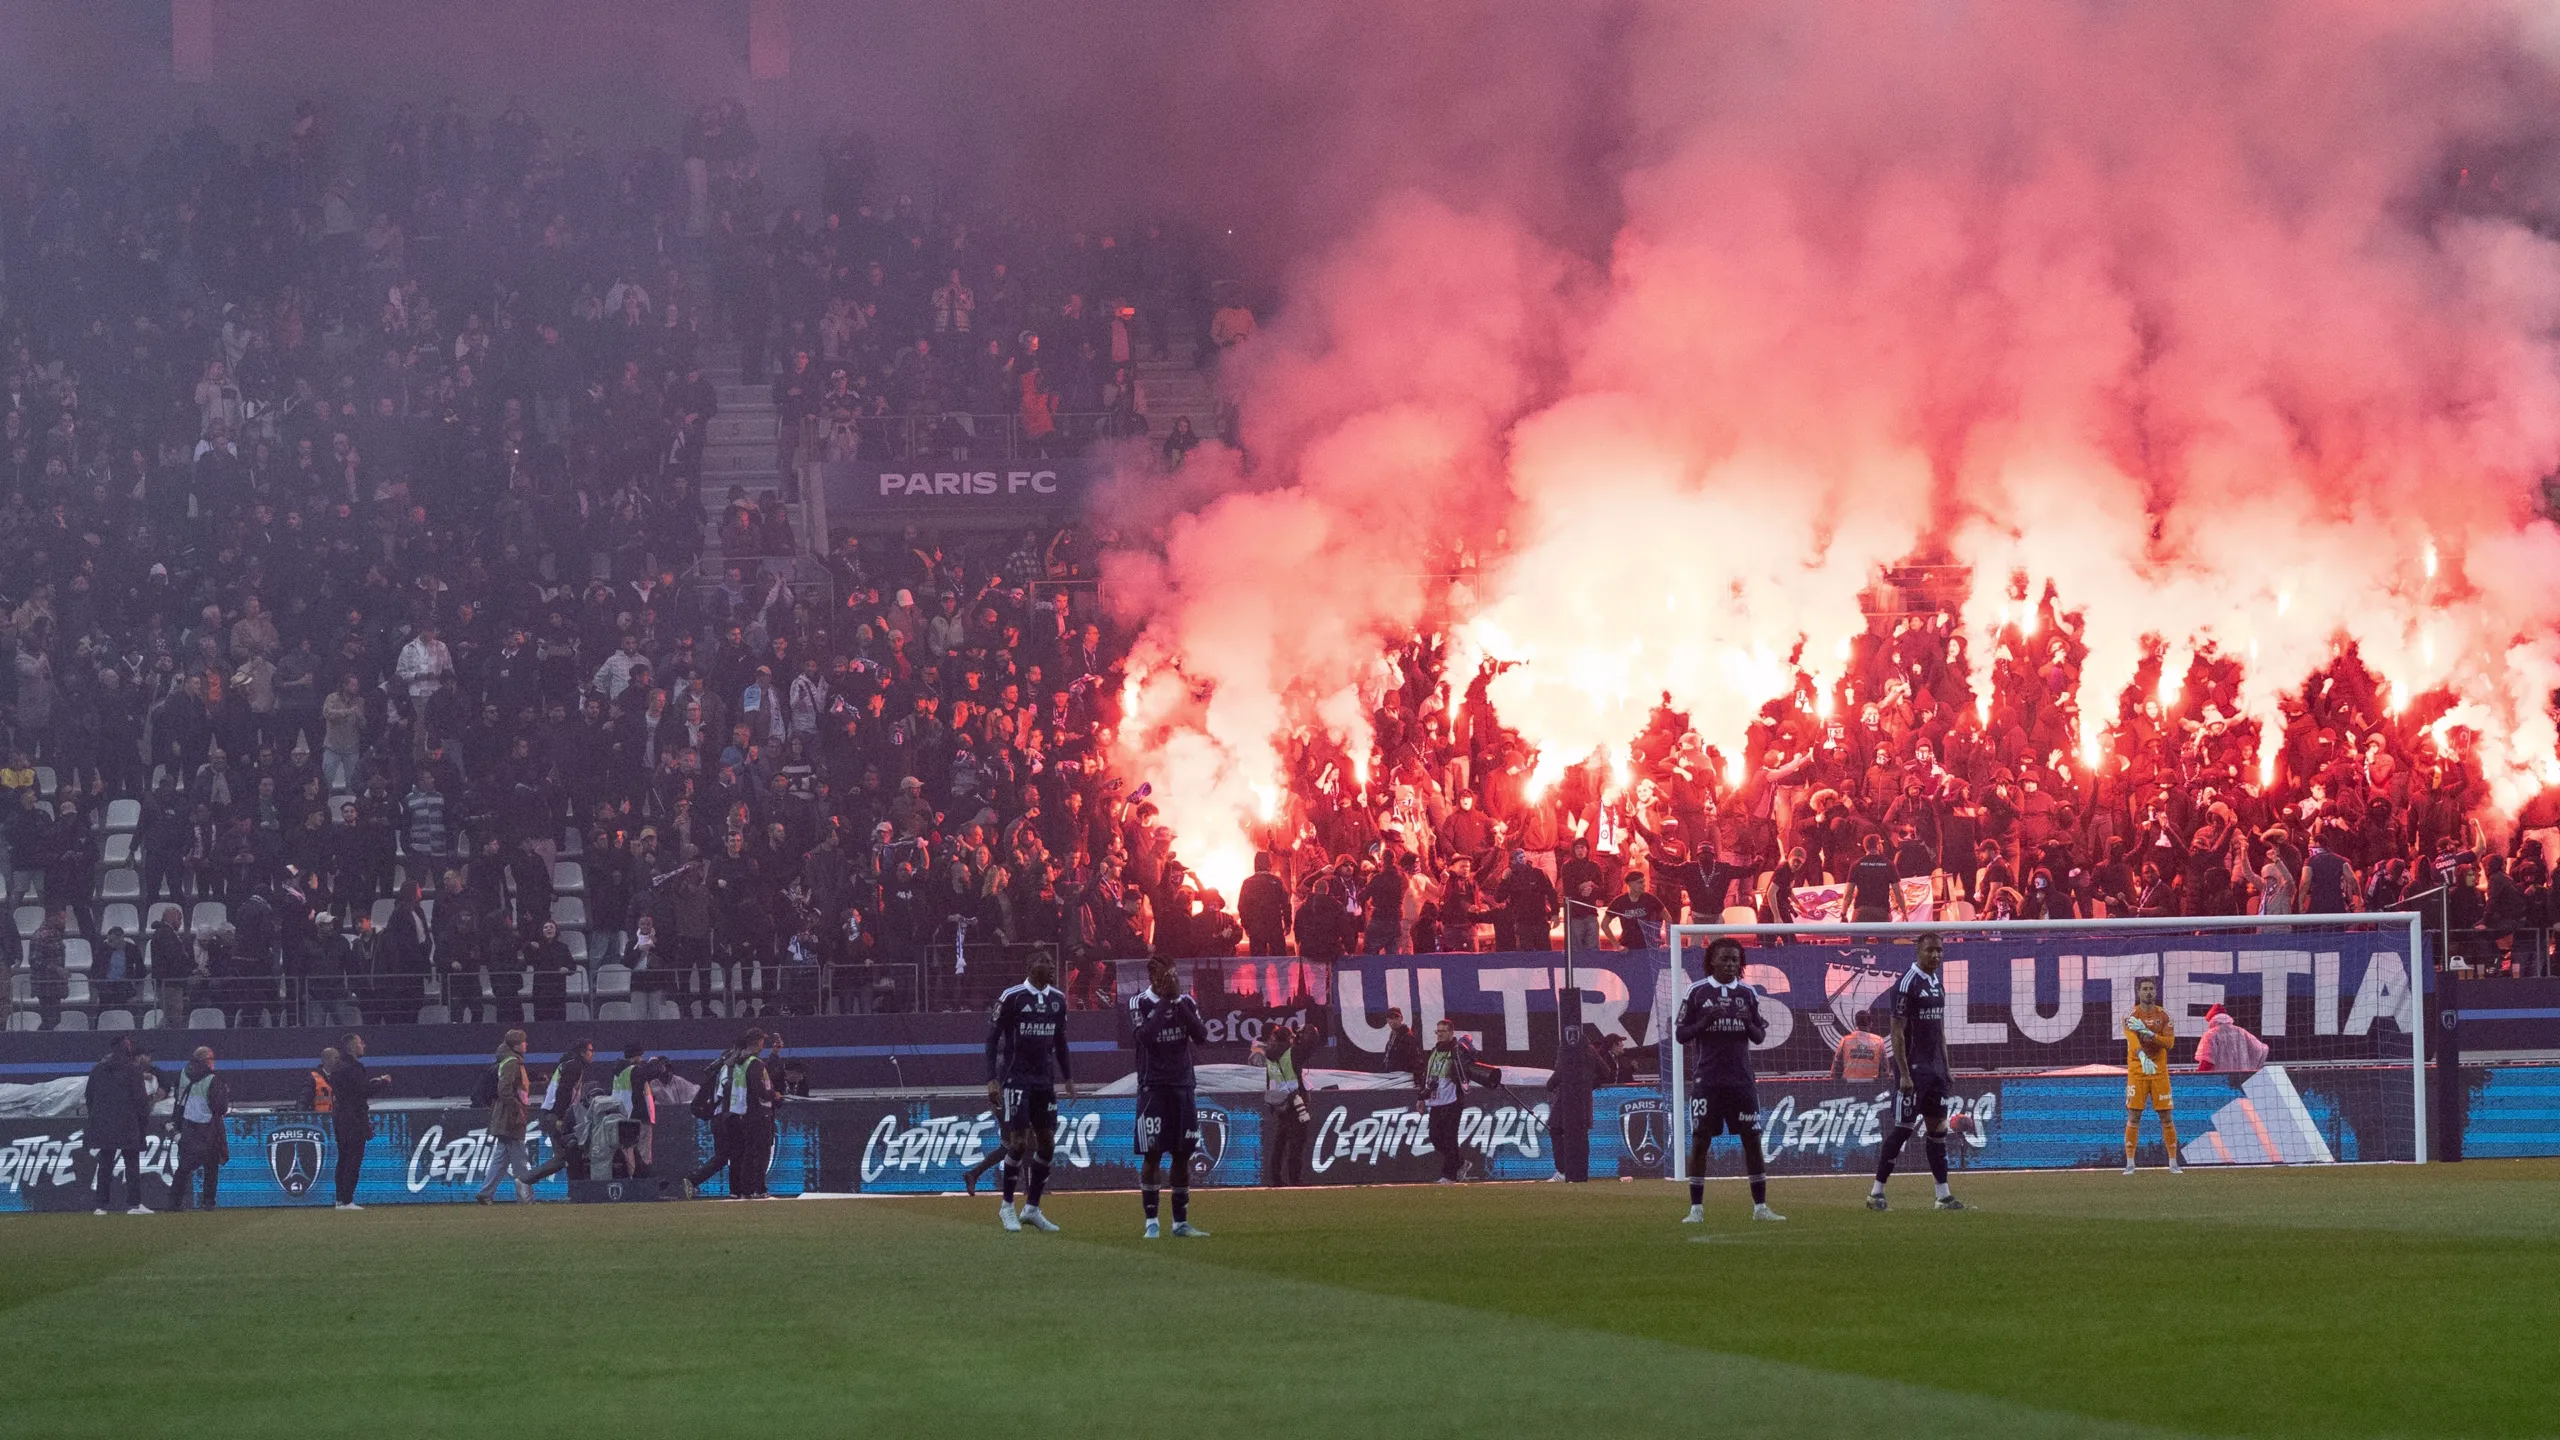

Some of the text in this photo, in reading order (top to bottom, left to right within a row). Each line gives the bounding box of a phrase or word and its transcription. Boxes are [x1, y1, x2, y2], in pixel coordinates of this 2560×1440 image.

[880, 471, 1057, 495] PARIS FC
[2440, 866, 2457, 885] 17
[1943, 949, 2414, 1046] LUTETIA
[1205, 1008, 1308, 1043] eford
[1010, 1089, 1023, 1106] 17
[1624, 1100, 1656, 1112] PARIS
[1210, 1111, 1225, 1121] FC
[1692, 1098, 1708, 1116] 23
[1145, 1116, 1162, 1135] 93
[271, 1130, 321, 1142] PARIS FC
